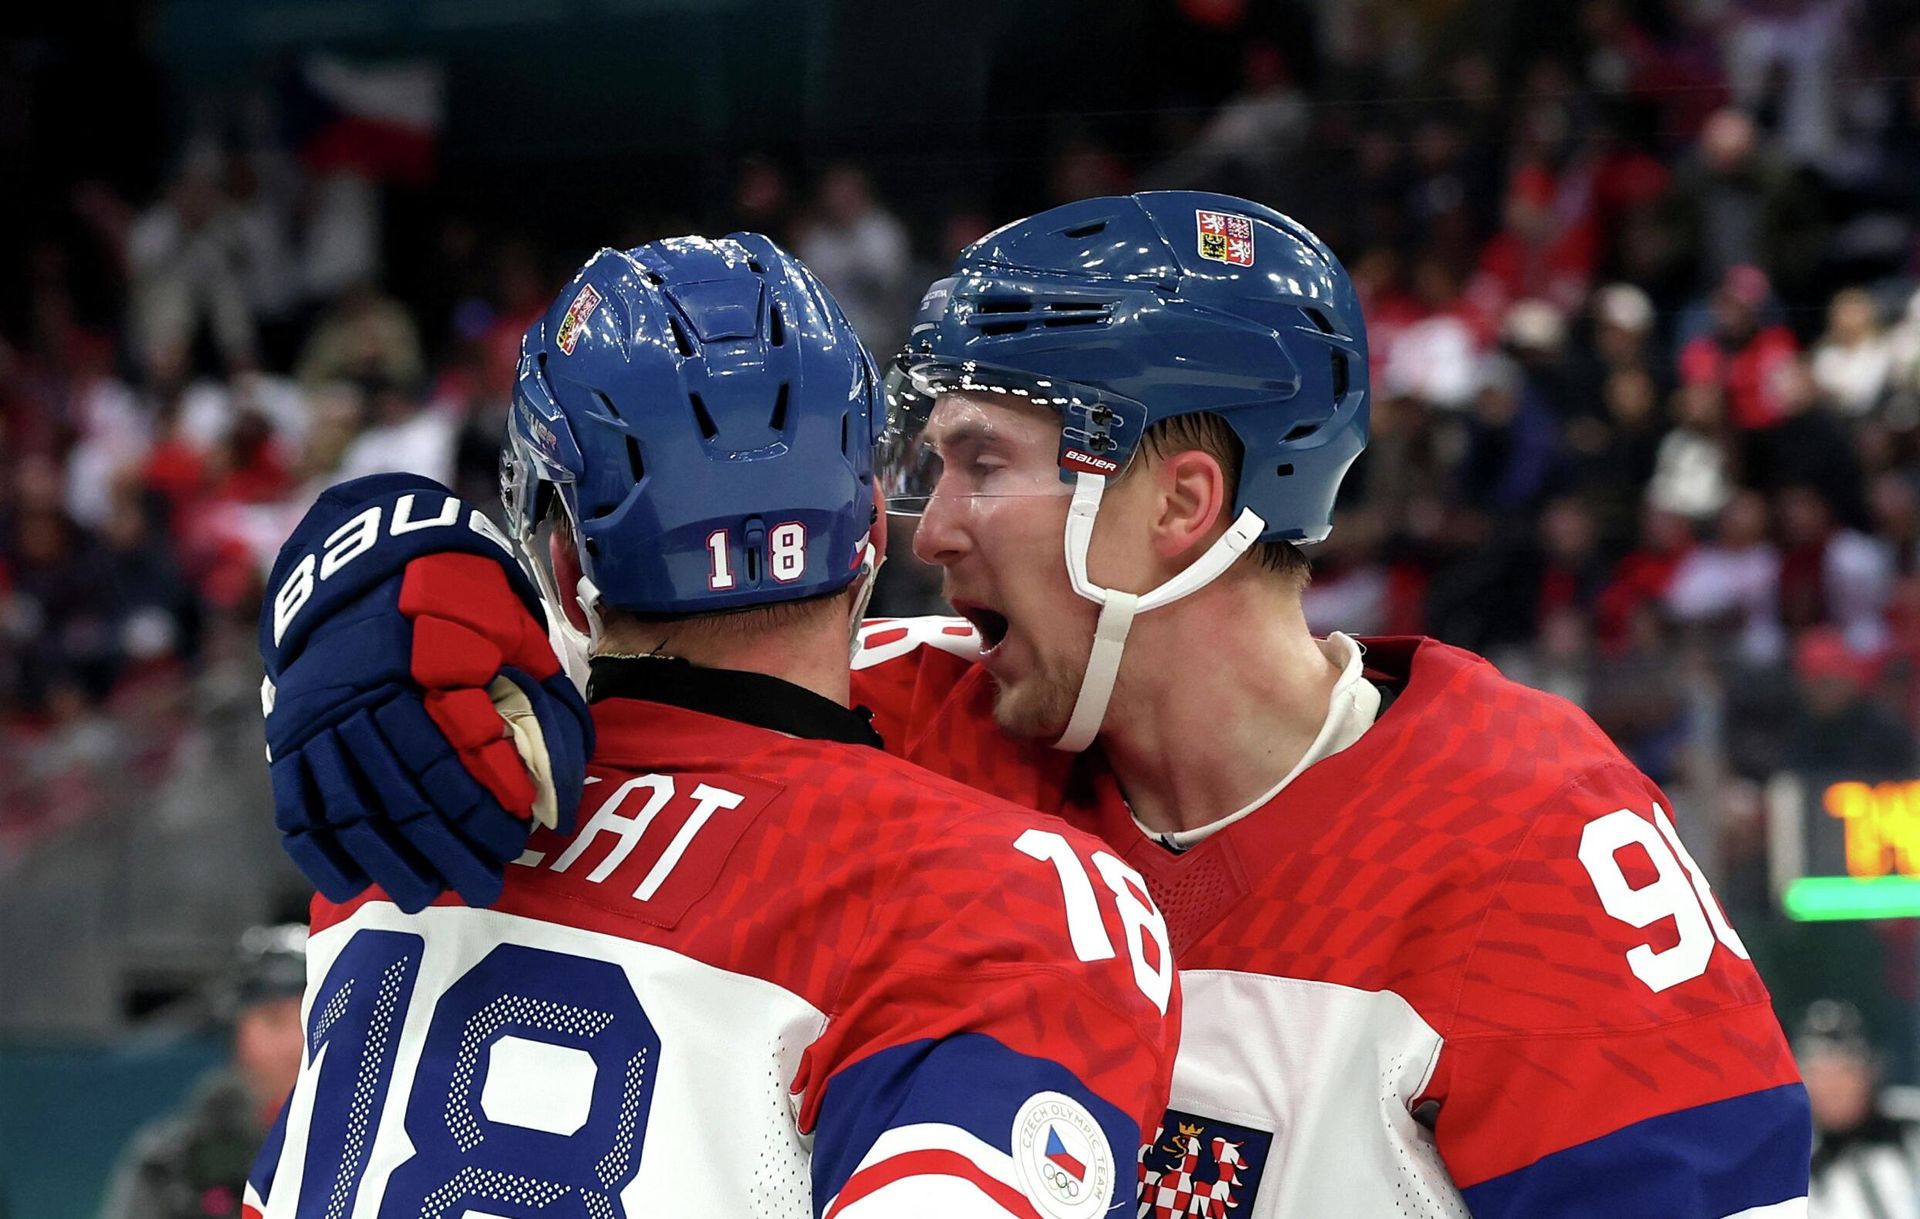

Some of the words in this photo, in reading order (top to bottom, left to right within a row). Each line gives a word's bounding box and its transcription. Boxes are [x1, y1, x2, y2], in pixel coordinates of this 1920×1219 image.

[1065, 450, 1117, 472] BAUER
[273, 494, 526, 648] BAU
[1012, 828, 1173, 1018] 18
[296, 928, 661, 1219] 18
[1022, 1106, 1049, 1149] CZECH
[1051, 1104, 1101, 1149] OLYMPIC
[1094, 1156, 1106, 1201] TEAM
